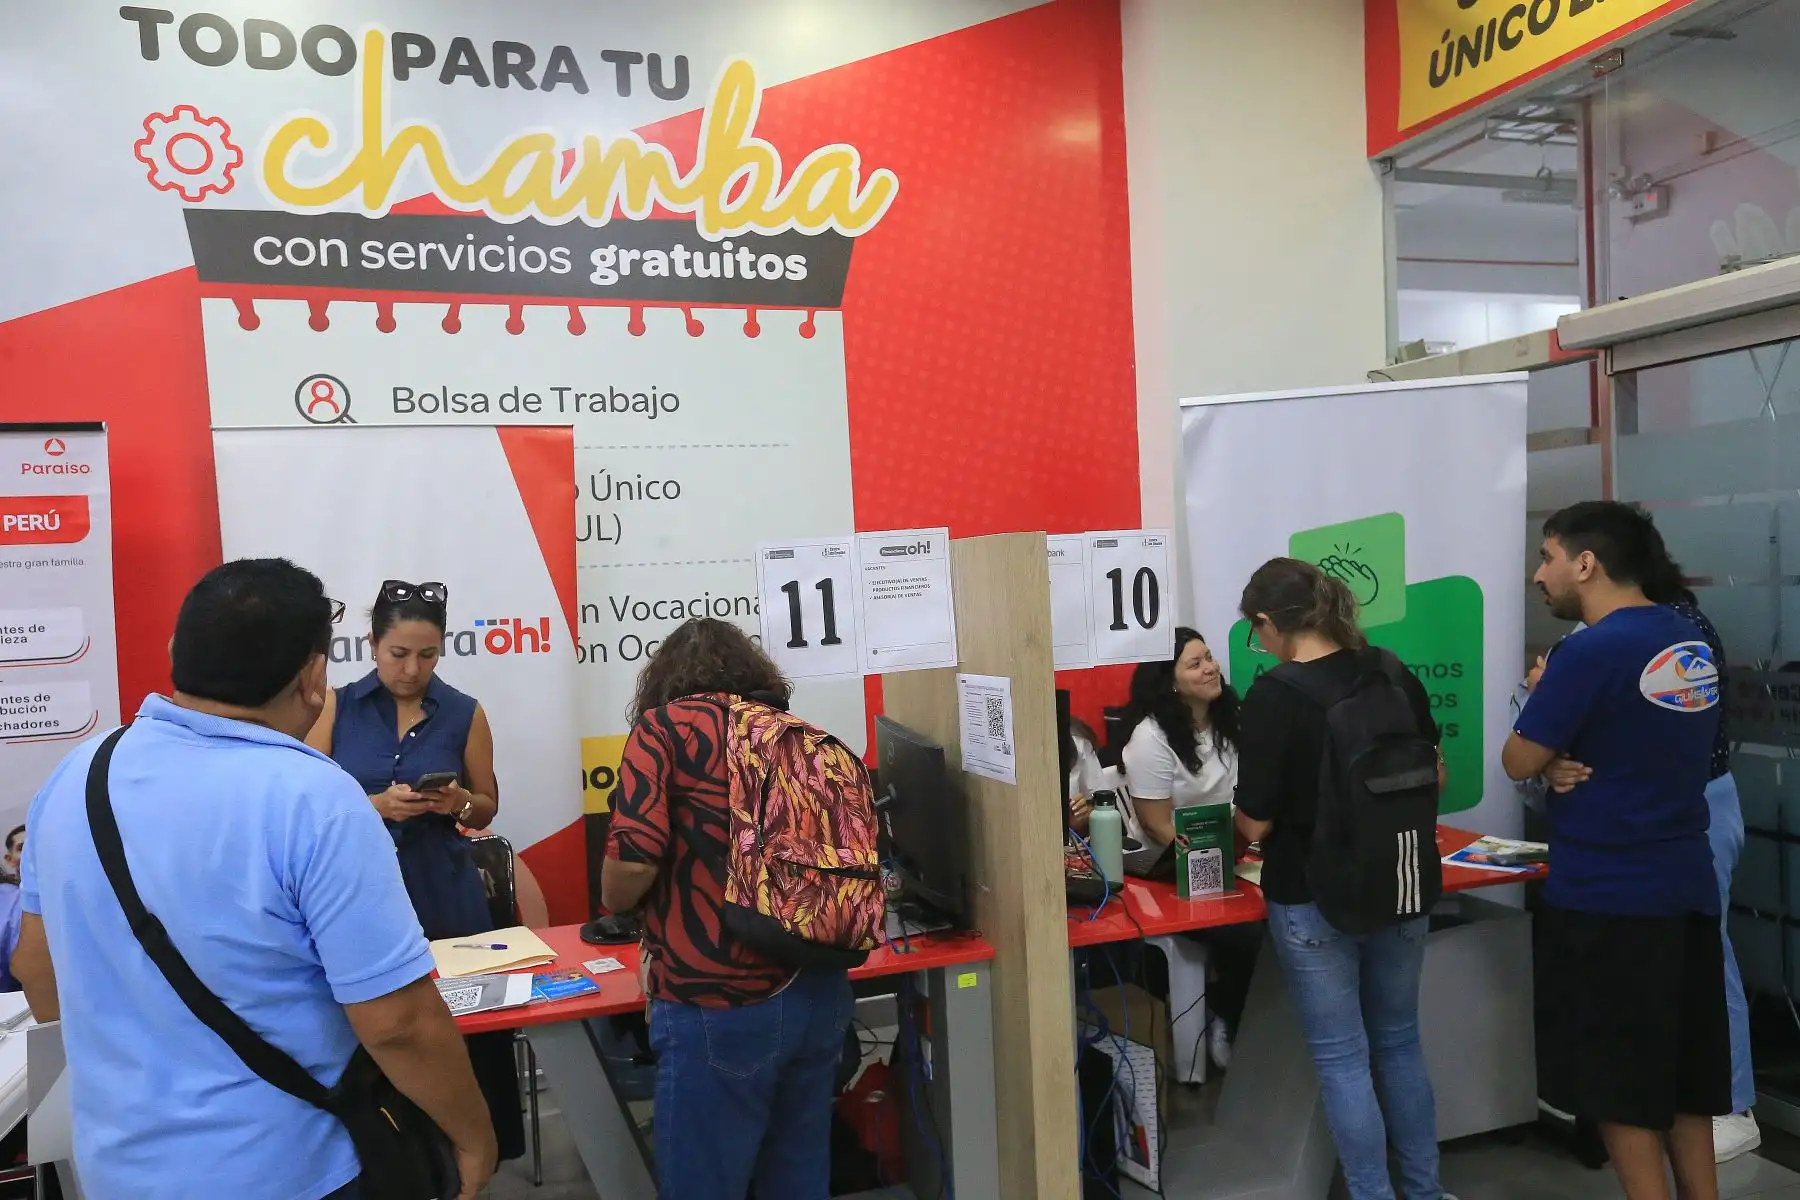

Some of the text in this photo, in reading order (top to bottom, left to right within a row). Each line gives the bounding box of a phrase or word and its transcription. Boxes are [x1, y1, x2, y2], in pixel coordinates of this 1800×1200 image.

[119, 5, 690, 101] TODO PARA TU
[1429, 0, 1560, 88] ÚNICO
[262, 29, 896, 236] chamba
[253, 234, 808, 285] con servicios gratuitos
[392, 385, 680, 420] Bolsa de Trabajo
[21, 462, 90, 475] Paraiso
[591, 469, 681, 502] Único
[3, 509, 61, 531] PERÚ
[24, 560, 49, 570] gran
[51, 557, 84, 567] familia
[908, 541, 930, 554] oh!
[780, 577, 843, 649] 11
[1106, 566, 1160, 630] 10
[0, 635, 28, 645] ieza
[28, 624, 45, 633] de
[34, 693, 51, 703] de
